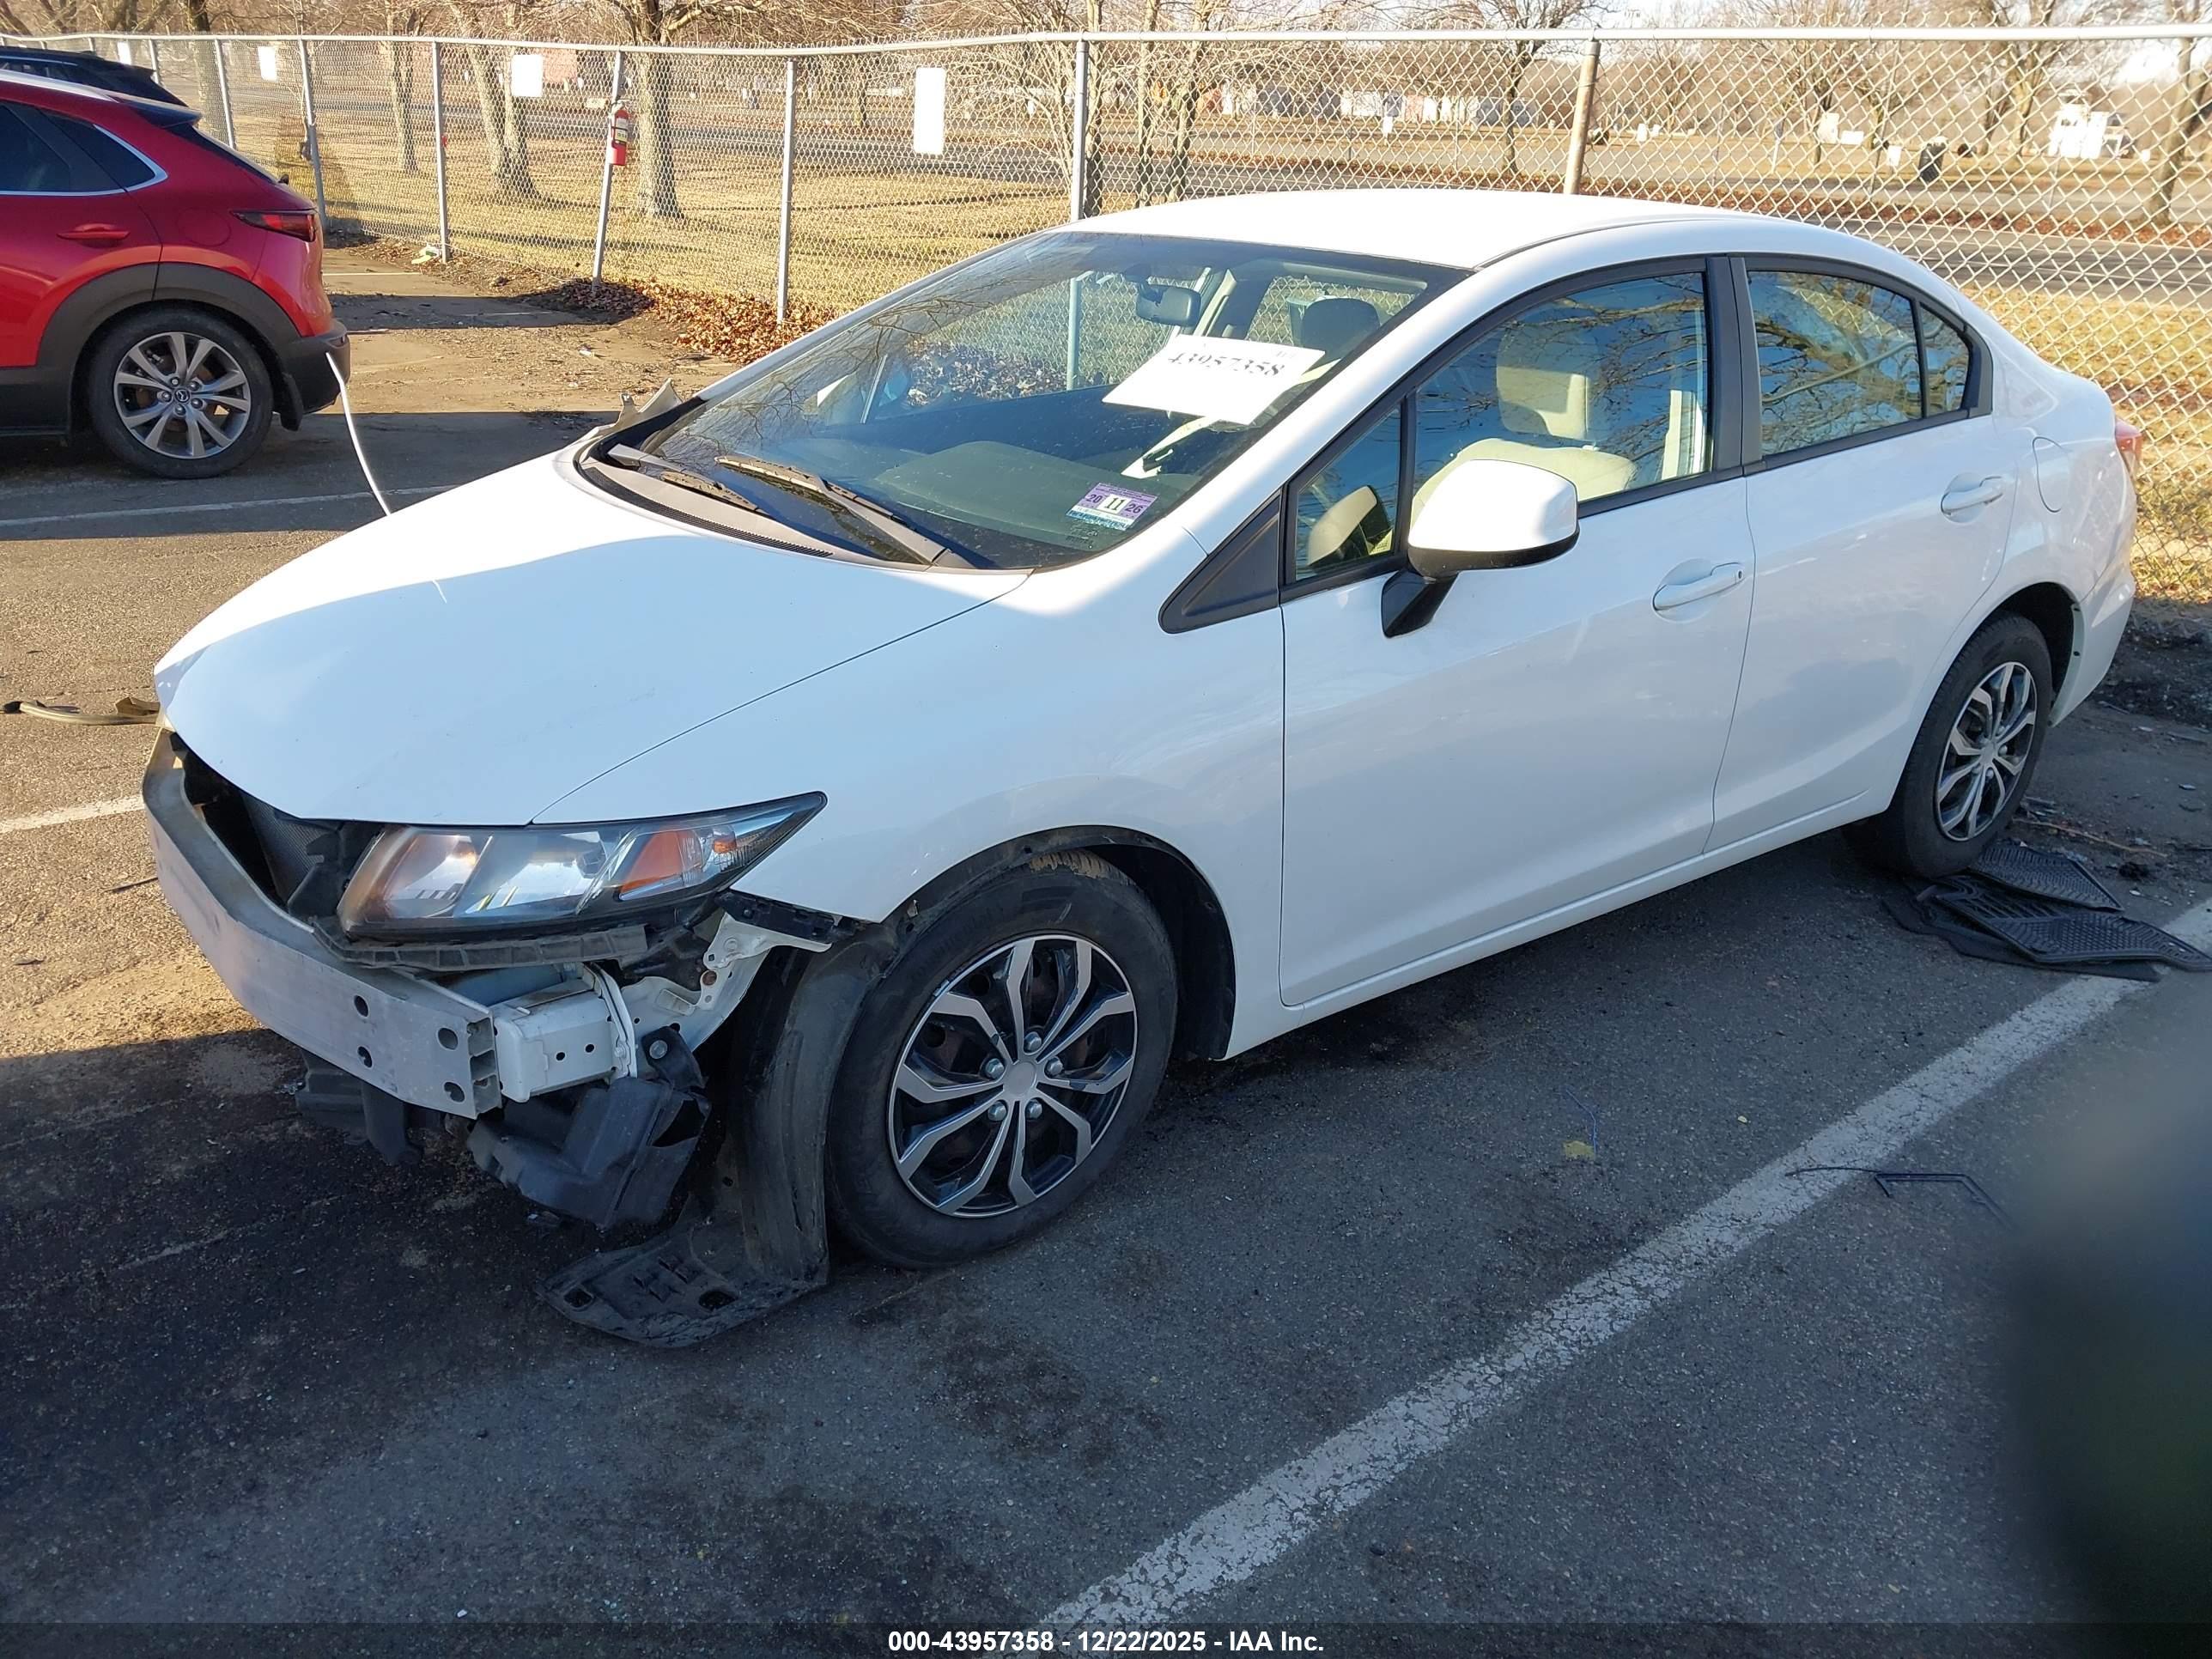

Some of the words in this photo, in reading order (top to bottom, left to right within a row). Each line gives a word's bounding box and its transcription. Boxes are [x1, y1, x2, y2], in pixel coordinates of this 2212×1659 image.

[1168, 351, 1285, 376] 43957358
[1086, 494, 1103, 504] 20
[1104, 497, 1126, 511] 11
[1125, 503, 1143, 514] 26
